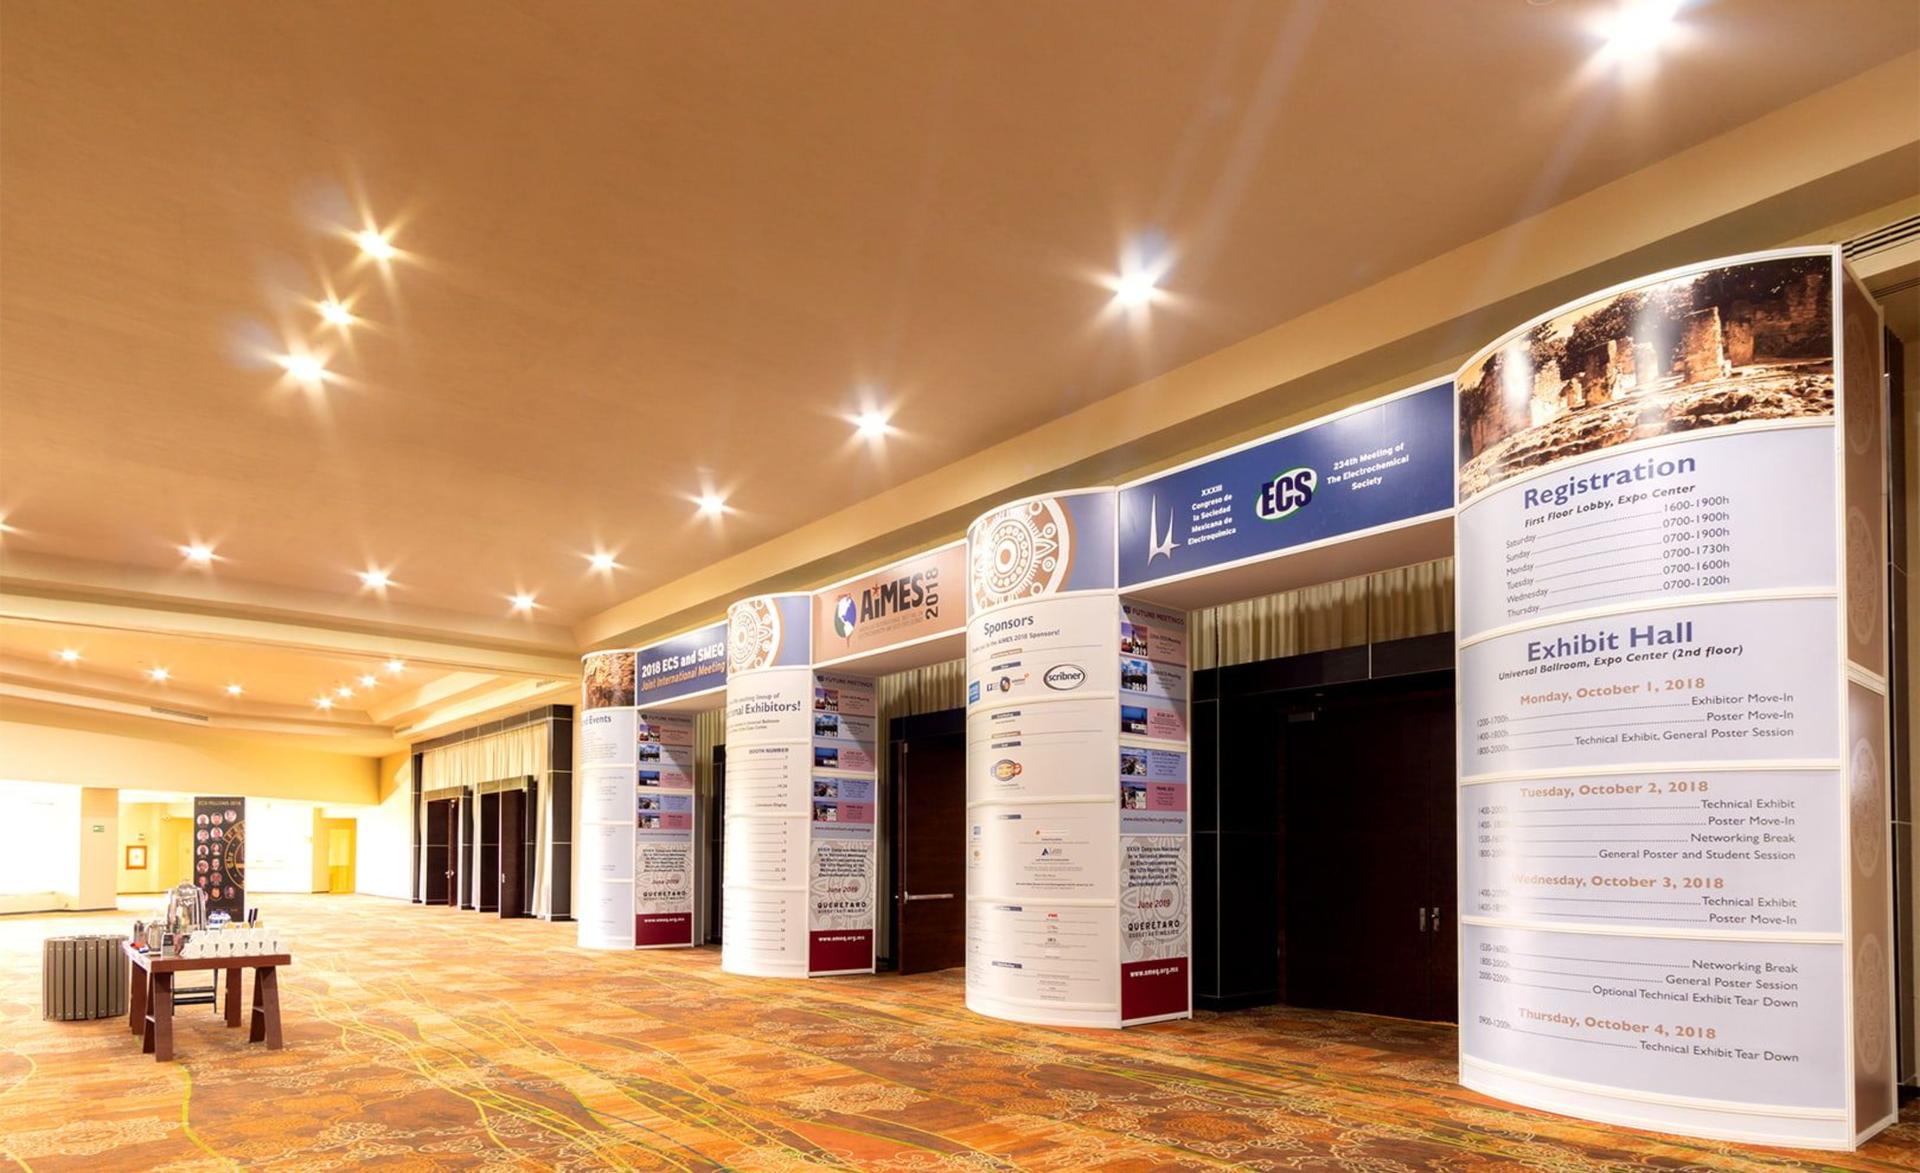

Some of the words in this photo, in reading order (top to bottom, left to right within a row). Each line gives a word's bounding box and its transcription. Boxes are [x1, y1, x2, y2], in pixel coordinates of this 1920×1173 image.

[1333, 457, 1358, 470] 234th
[1359, 447, 1393, 462] Meeting
[1394, 442, 1404, 452] of
[1326, 475, 1341, 484] The
[1343, 454, 1409, 480] Electrochemical
[1261, 470, 1313, 516] ECS
[1351, 476, 1383, 490] Society
[1524, 456, 1696, 510] Registration
[1192, 497, 1222, 510] Congreso
[1224, 493, 1232, 501] de
[1201, 505, 1231, 519] Sociedad
[1524, 516, 1545, 528] First
[1547, 508, 1574, 521] Floor
[1576, 500, 1614, 514] Lobby,
[1618, 493, 1648, 505] Expo
[1652, 484, 1696, 498] Center
[1192, 520, 1222, 533] Mexicana
[1224, 517, 1232, 525] de
[1505, 534, 1537, 549] Saturday
[1664, 496, 1729, 512] 1600-1900h
[1505, 550, 1531, 563] Sunday
[1662, 511, 1730, 528] 0700-1900h
[1506, 563, 1535, 576] Monday
[1662, 527, 1730, 543] 0700-1900h
[1506, 577, 1535, 590] Tuesday
[1662, 543, 1730, 559] 0700-1730h
[1506, 588, 1549, 603] Wednesday
[1662, 559, 1730, 575] 0700-1600h
[860, 573, 924, 623] AiMES
[925, 567, 939, 620] 2018
[1507, 605, 1540, 617] Thursday
[1662, 575, 1730, 591] 0700-1200h
[984, 615, 1034, 637] Sponsors
[1527, 631, 1619, 662] Exhibit
[1630, 621, 1693, 648] Hall
[641, 660, 661, 678] 2018
[662, 656, 679, 672] ECS
[680, 650, 696, 667] and
[697, 642, 725, 662] SMEQ
[1498, 667, 1537, 680] Universal
[1540, 661, 1590, 674] Ballroom,
[1593, 656, 1622, 667] Expo
[1626, 651, 1668, 662] Center
[1672, 647, 1701, 661] (2nd
[1705, 644, 1744, 658] floor)
[641, 677, 656, 691] Joint
[656, 668, 697, 687] International
[698, 661, 725, 676] Meeting
[1048, 671, 1081, 682] scribner
[1520, 691, 1572, 705] Monday,
[1576, 684, 1640, 698] October
[1648, 681, 1659, 692] 1,
[1665, 677, 1705, 691] 2018
[1691, 695, 1744, 706] Exhibitor
[1748, 693, 1794, 703] Move-In
[745, 700, 801, 714] Exhibitors!
[1706, 711, 1744, 722] Poster
[1748, 710, 1794, 720] Move-In
[589, 715, 611, 725] Events
[1575, 734, 1618, 745] Technical
[1663, 730, 1708, 741] General
[1711, 728, 1749, 739] Poster
[1752, 727, 1794, 737] Session
[1520, 786, 1575, 799] Tuesday,
[1579, 784, 1643, 796] October
[1648, 782, 1662, 794] 2,
[1668, 781, 1709, 793] 2018
[1701, 799, 1753, 809] Technical
[1756, 798, 1795, 809] Exhibit
[1708, 817, 1745, 826] Poster
[1749, 816, 1795, 826] Move-In
[1690, 833, 1760, 845] Networking
[1763, 833, 1796, 843] Break
[1598, 849, 1640, 859] General
[1643, 850, 1680, 859] Poster
[1682, 850, 1702, 859] and
[1706, 850, 1751, 860] Student
[1754, 850, 1796, 860] Session
[1512, 873, 1587, 888] Wednesday,
[1591, 875, 1657, 888] October
[1662, 876, 1677, 889] 3,
[1683, 877, 1724, 889] 2018
[1702, 896, 1754, 907] Technical
[1757, 897, 1797, 908] Exhibit
[1709, 913, 1747, 924] Poster
[1750, 914, 1797, 925] Move-In
[1692, 959, 1762, 974] Networking
[1765, 962, 1799, 973] Break
[1665, 974, 1711, 986] General
[1714, 977, 1753, 988] Poster
[1755, 979, 1799, 990] Session
[1592, 985, 1637, 998] Optional
[1639, 989, 1689, 1002] Technical
[1692, 993, 1732, 1005] Exhibit
[1734, 995, 1759, 1006] Tear
[1763, 997, 1799, 1008] Down
[1518, 1007, 1580, 1027] Thursday,
[1584, 1016, 1650, 1033] October
[1654, 1024, 1669, 1037] 4,
[1675, 1025, 1717, 1039] 2018
[1639, 1040, 1689, 1054] Technical
[1693, 1045, 1733, 1058] Exhibit
[1735, 1049, 1760, 1060] Tear
[1763, 1051, 1800, 1062] Down
